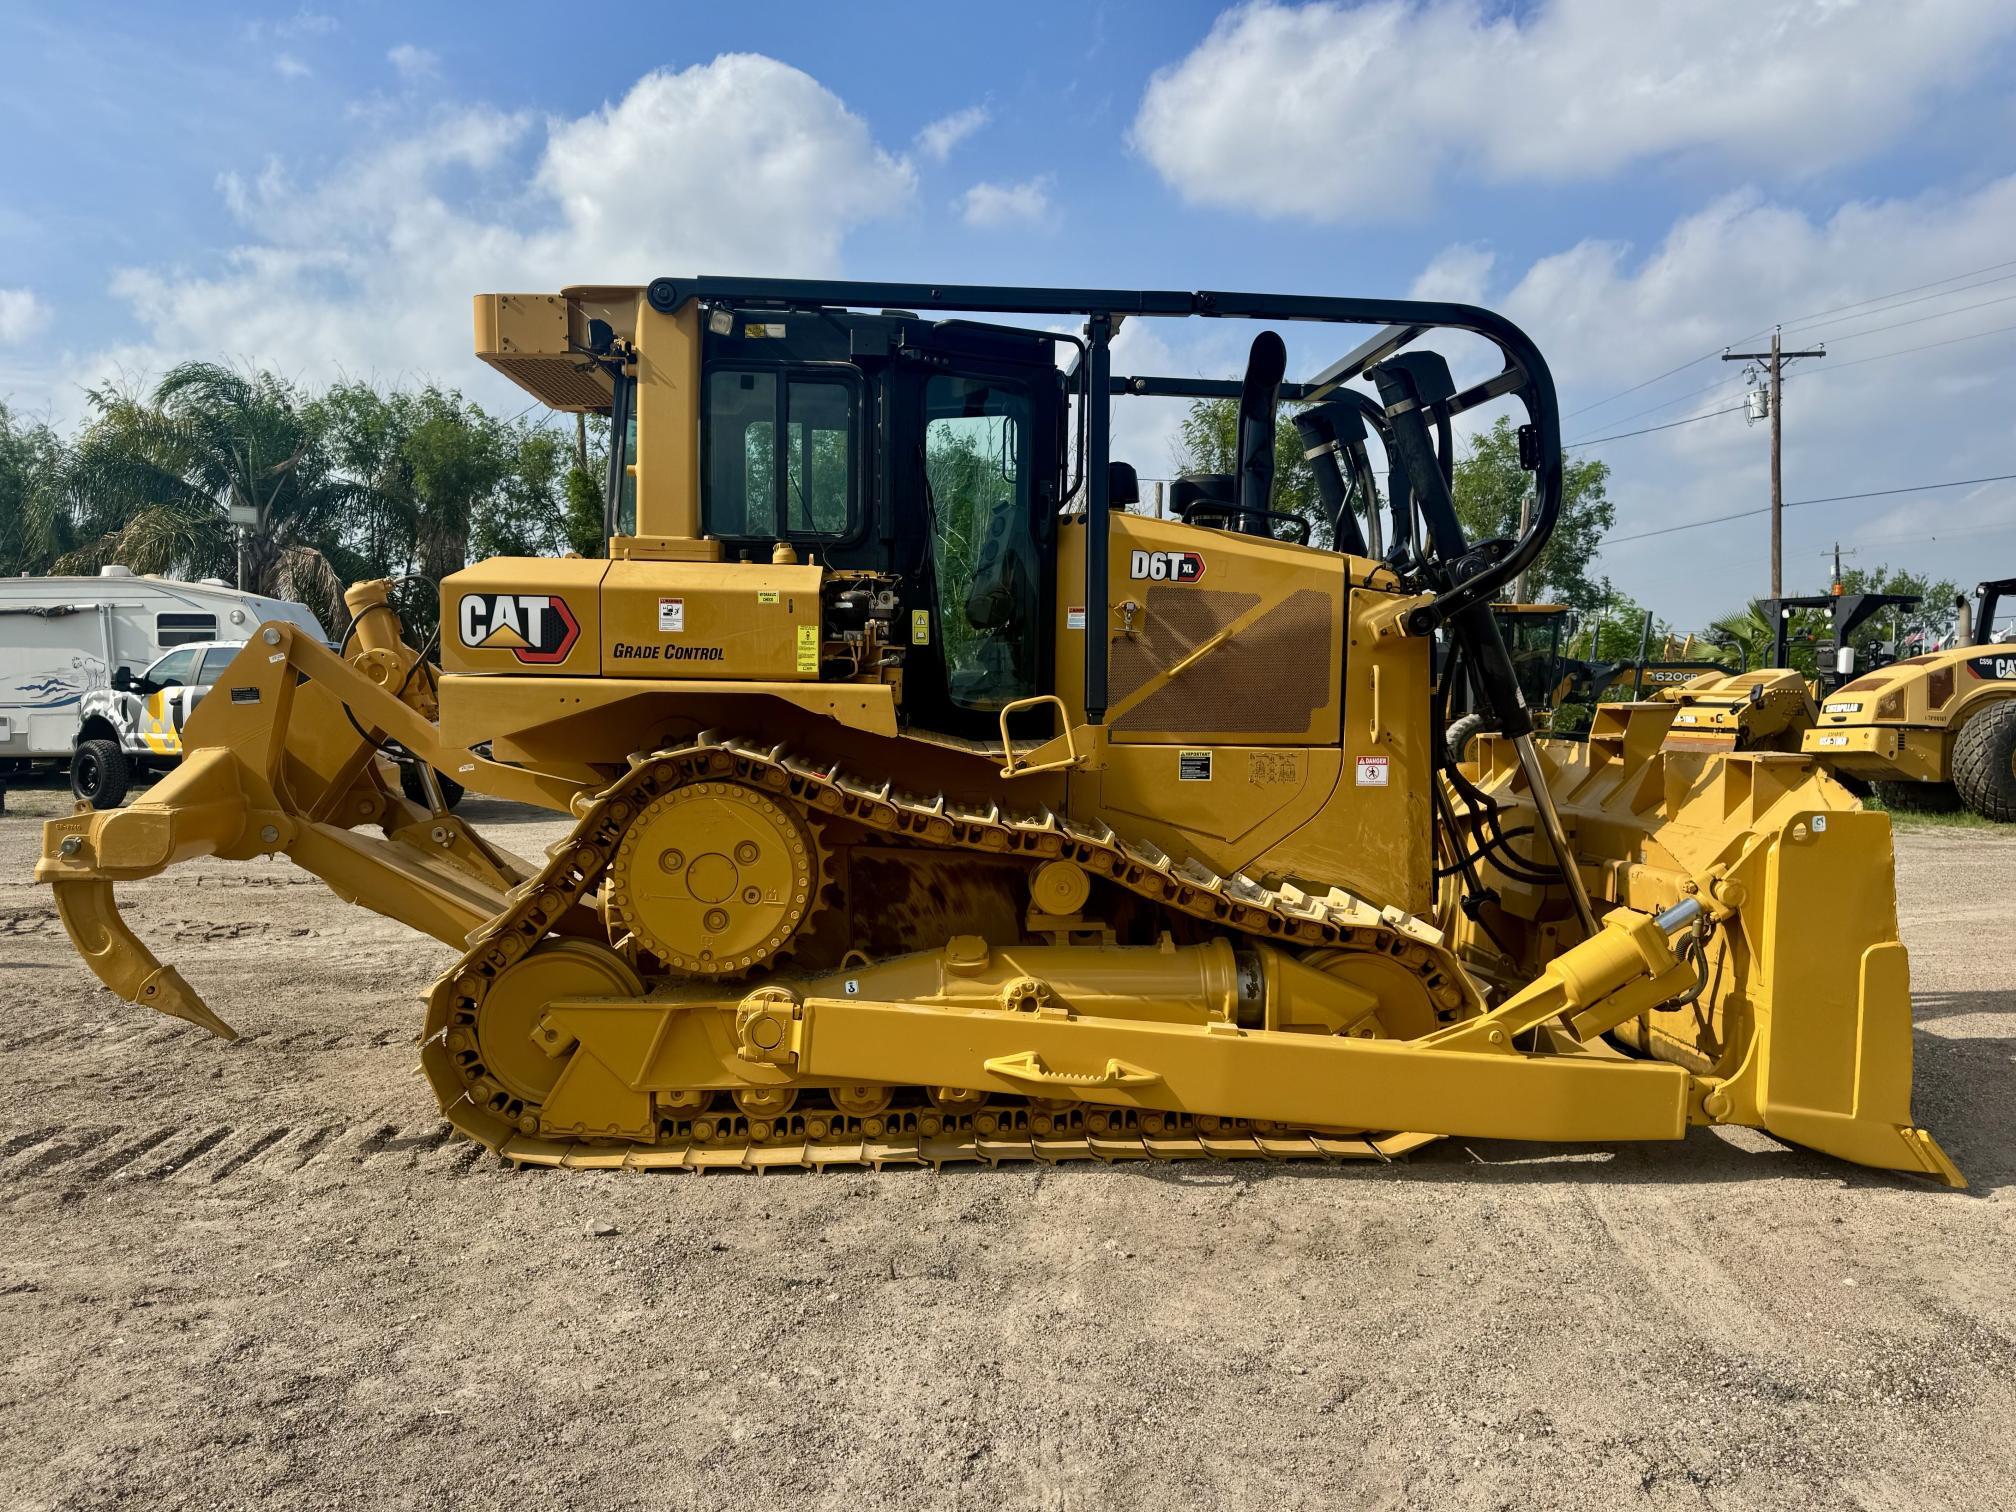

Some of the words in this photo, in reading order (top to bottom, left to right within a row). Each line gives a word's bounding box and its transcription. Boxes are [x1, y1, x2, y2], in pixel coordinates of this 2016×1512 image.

[1130, 550, 1184, 581] D6T
[1182, 563, 1194, 574] XL
[460, 594, 550, 648] CAT
[613, 642, 661, 660] GRADE
[664, 643, 725, 661] CONTROL
[1995, 658, 2016, 679] CA
[1825, 702, 1860, 713] CATERPILLAR
[1365, 757, 1387, 765] DANGER
